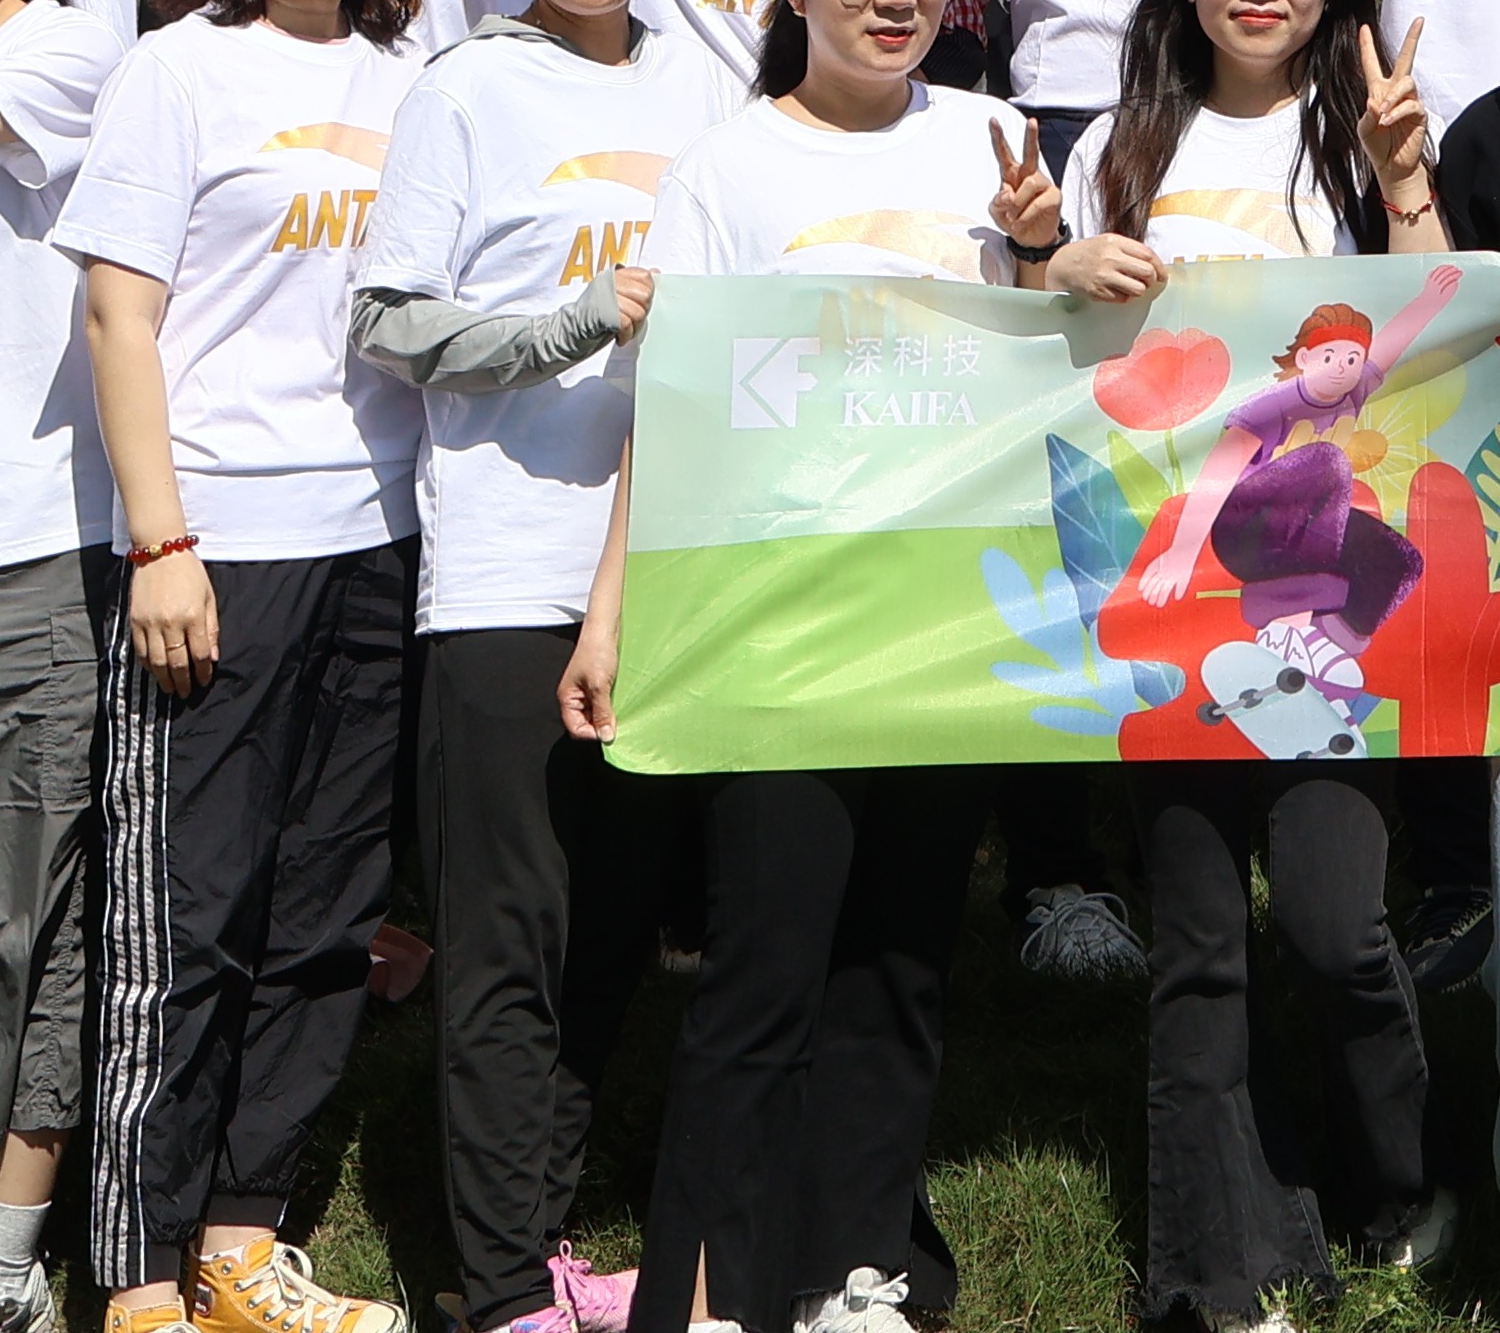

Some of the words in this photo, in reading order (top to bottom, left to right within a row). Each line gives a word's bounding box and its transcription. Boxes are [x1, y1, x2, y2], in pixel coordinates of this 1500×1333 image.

[271, 190, 379, 253] ANT
[844, 334, 982, 377] 深科技
[840, 391, 978, 426] KAIFA
